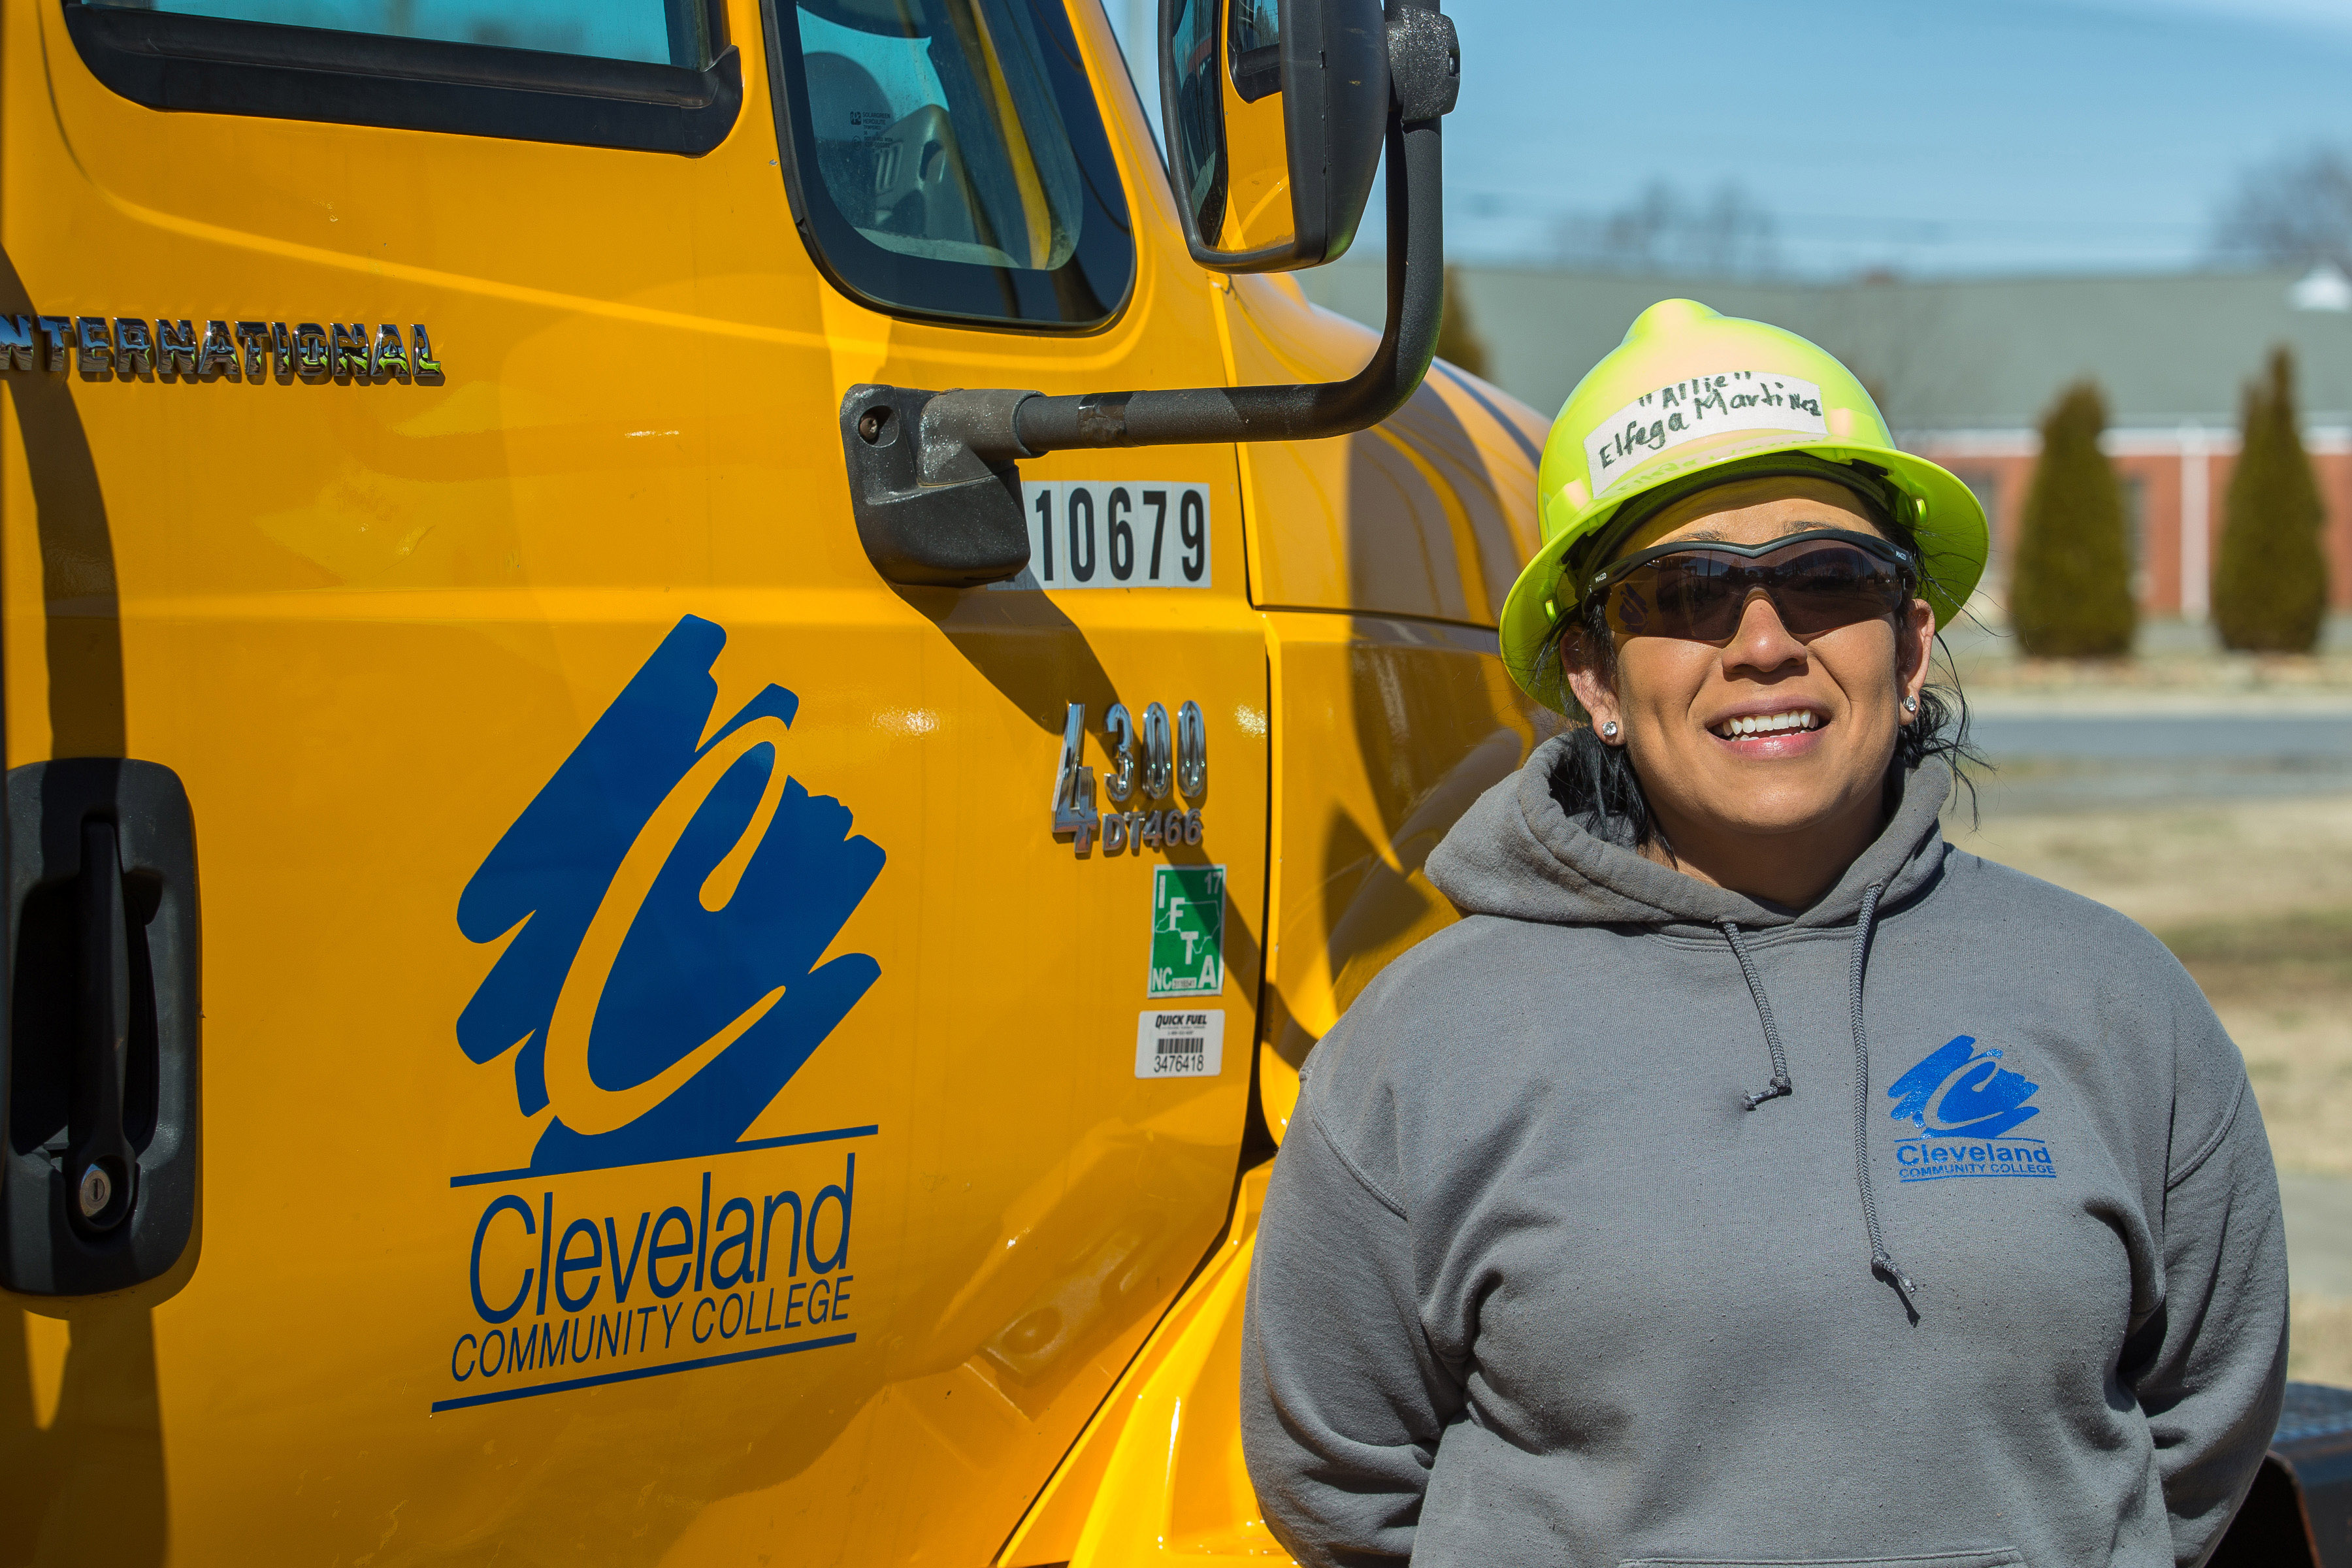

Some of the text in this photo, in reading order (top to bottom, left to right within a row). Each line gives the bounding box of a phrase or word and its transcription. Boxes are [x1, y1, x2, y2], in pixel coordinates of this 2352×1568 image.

[1051, 700, 1206, 853] 4300
[1102, 808, 1202, 851] DT466
[1204, 871, 1223, 894] 17
[1152, 967, 1173, 991] NC
[1155, 1014, 1207, 1029] QUICK FUEL
[1153, 1054, 1205, 1073] 3476418
[1897, 1143, 2052, 1166] Cleveland
[1899, 1164, 2056, 1178] COMMUNITY COLLEGE
[469, 1152, 856, 1324] Cleveland
[451, 1275, 855, 1382] COMMUNITY COLLEGE
